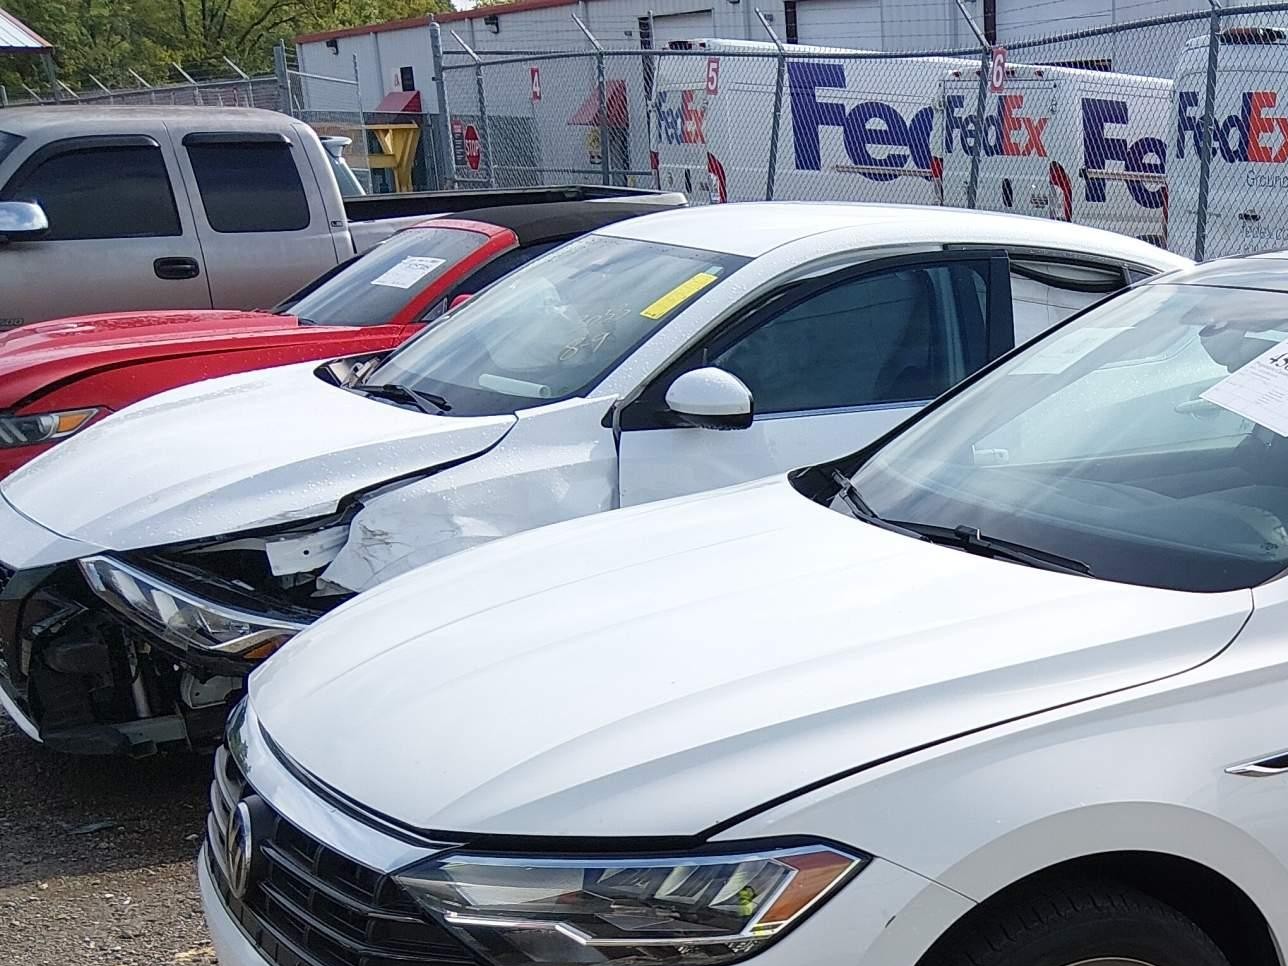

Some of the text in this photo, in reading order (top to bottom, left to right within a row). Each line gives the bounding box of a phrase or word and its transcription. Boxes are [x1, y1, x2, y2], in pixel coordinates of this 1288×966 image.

[533, 71, 539, 97] 4
[708, 62, 717, 90] 5
[993, 54, 1003, 87] 6
[655, 90, 706, 145] FedEx
[945, 95, 1049, 157] FedEx
[466, 139, 481, 156] STOP
